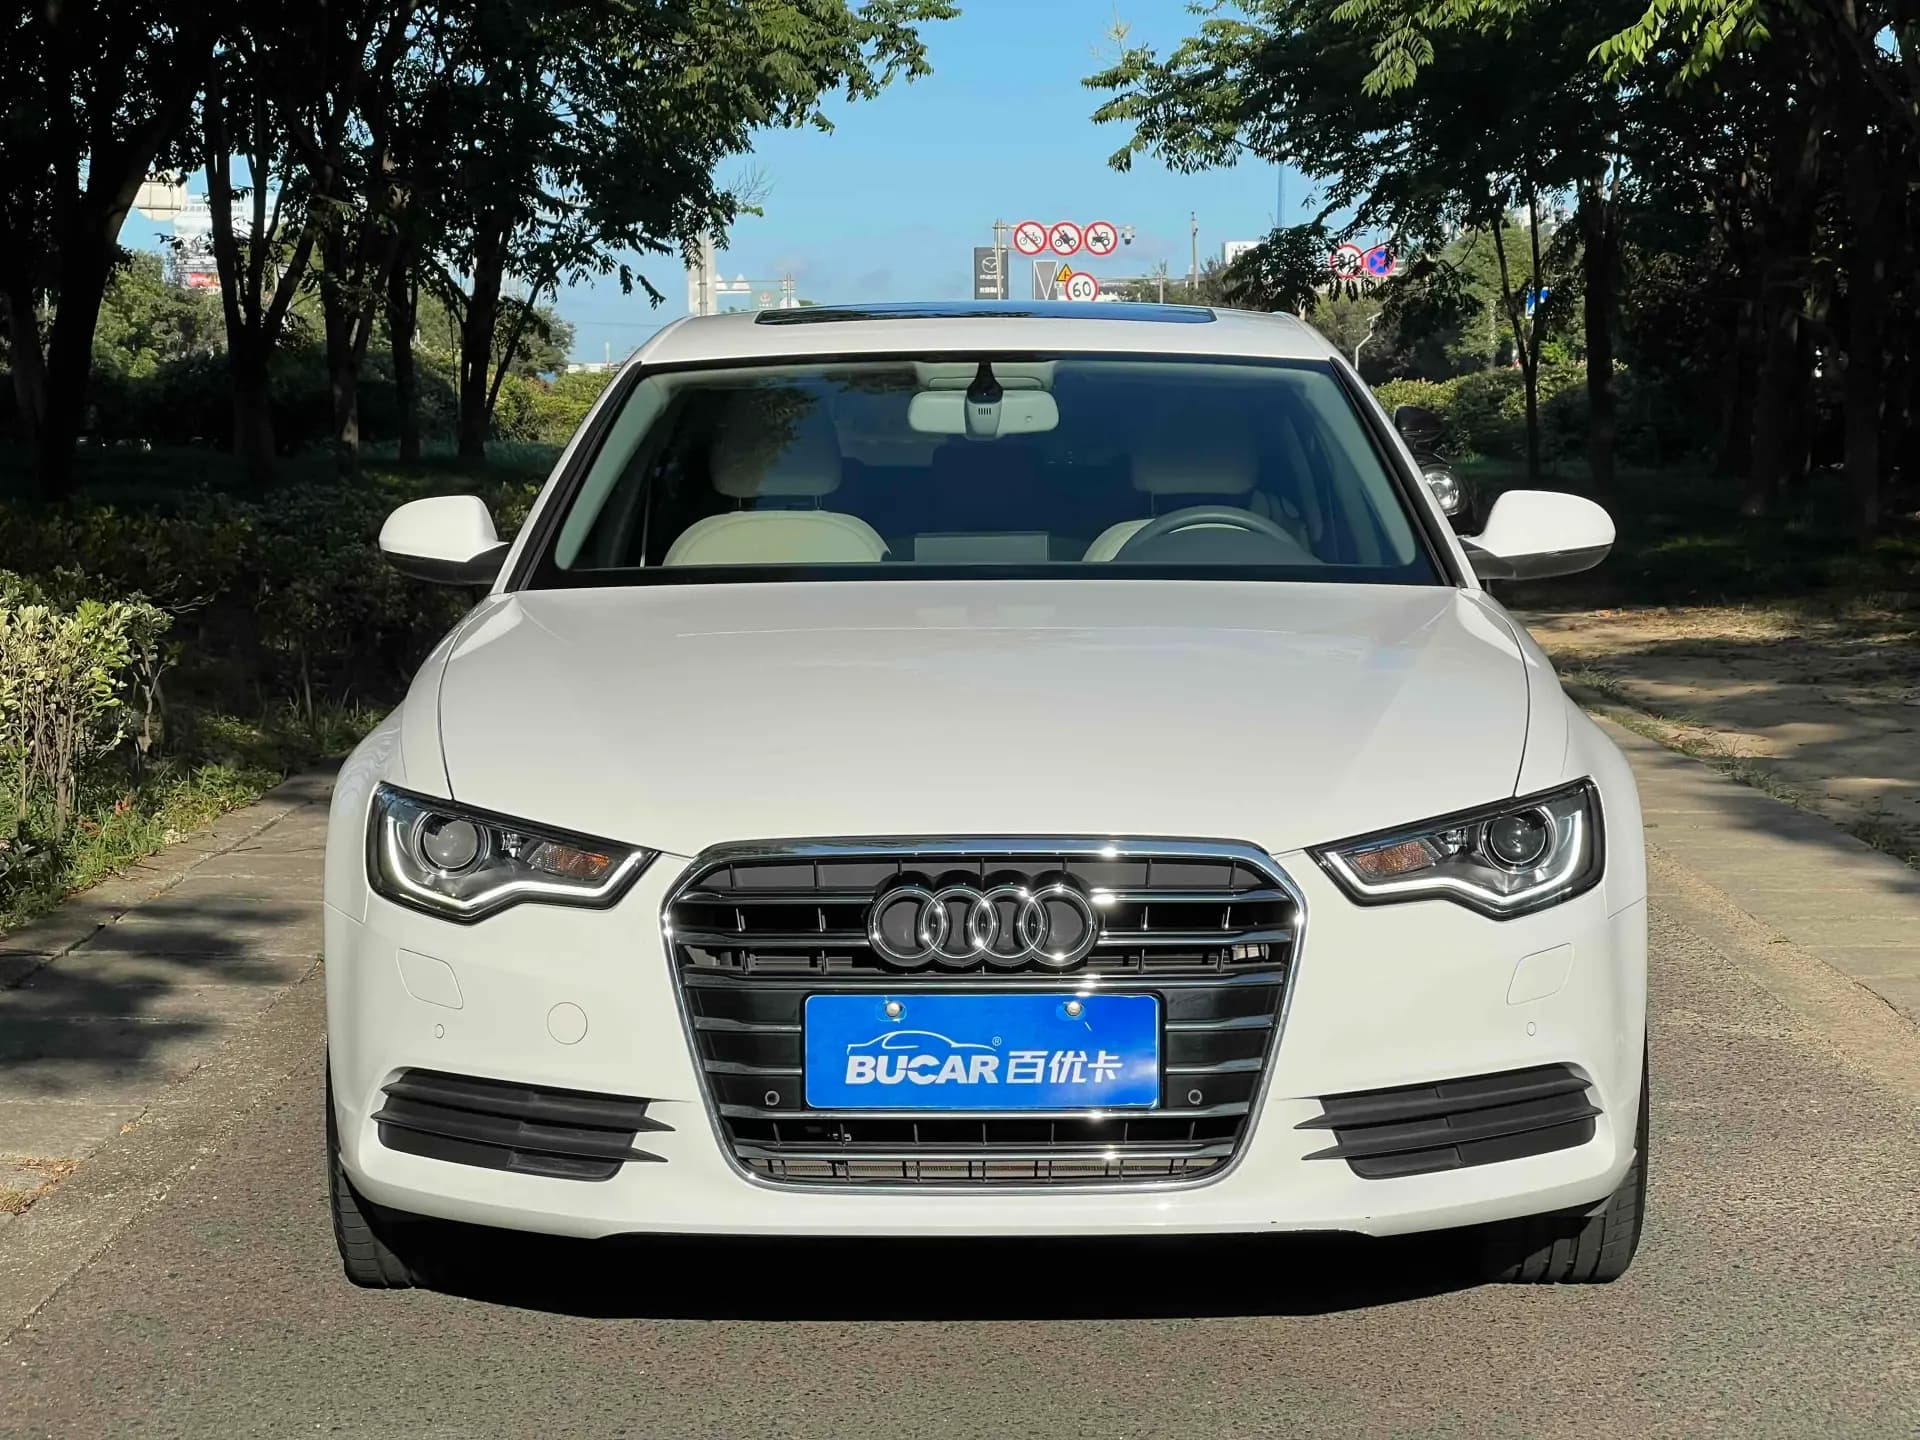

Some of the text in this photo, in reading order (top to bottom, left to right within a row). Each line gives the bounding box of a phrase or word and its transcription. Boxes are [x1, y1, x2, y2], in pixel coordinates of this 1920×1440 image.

[1072, 281, 1092, 298] 60
[845, 1050, 1123, 1085] BUCAR 百优卡
